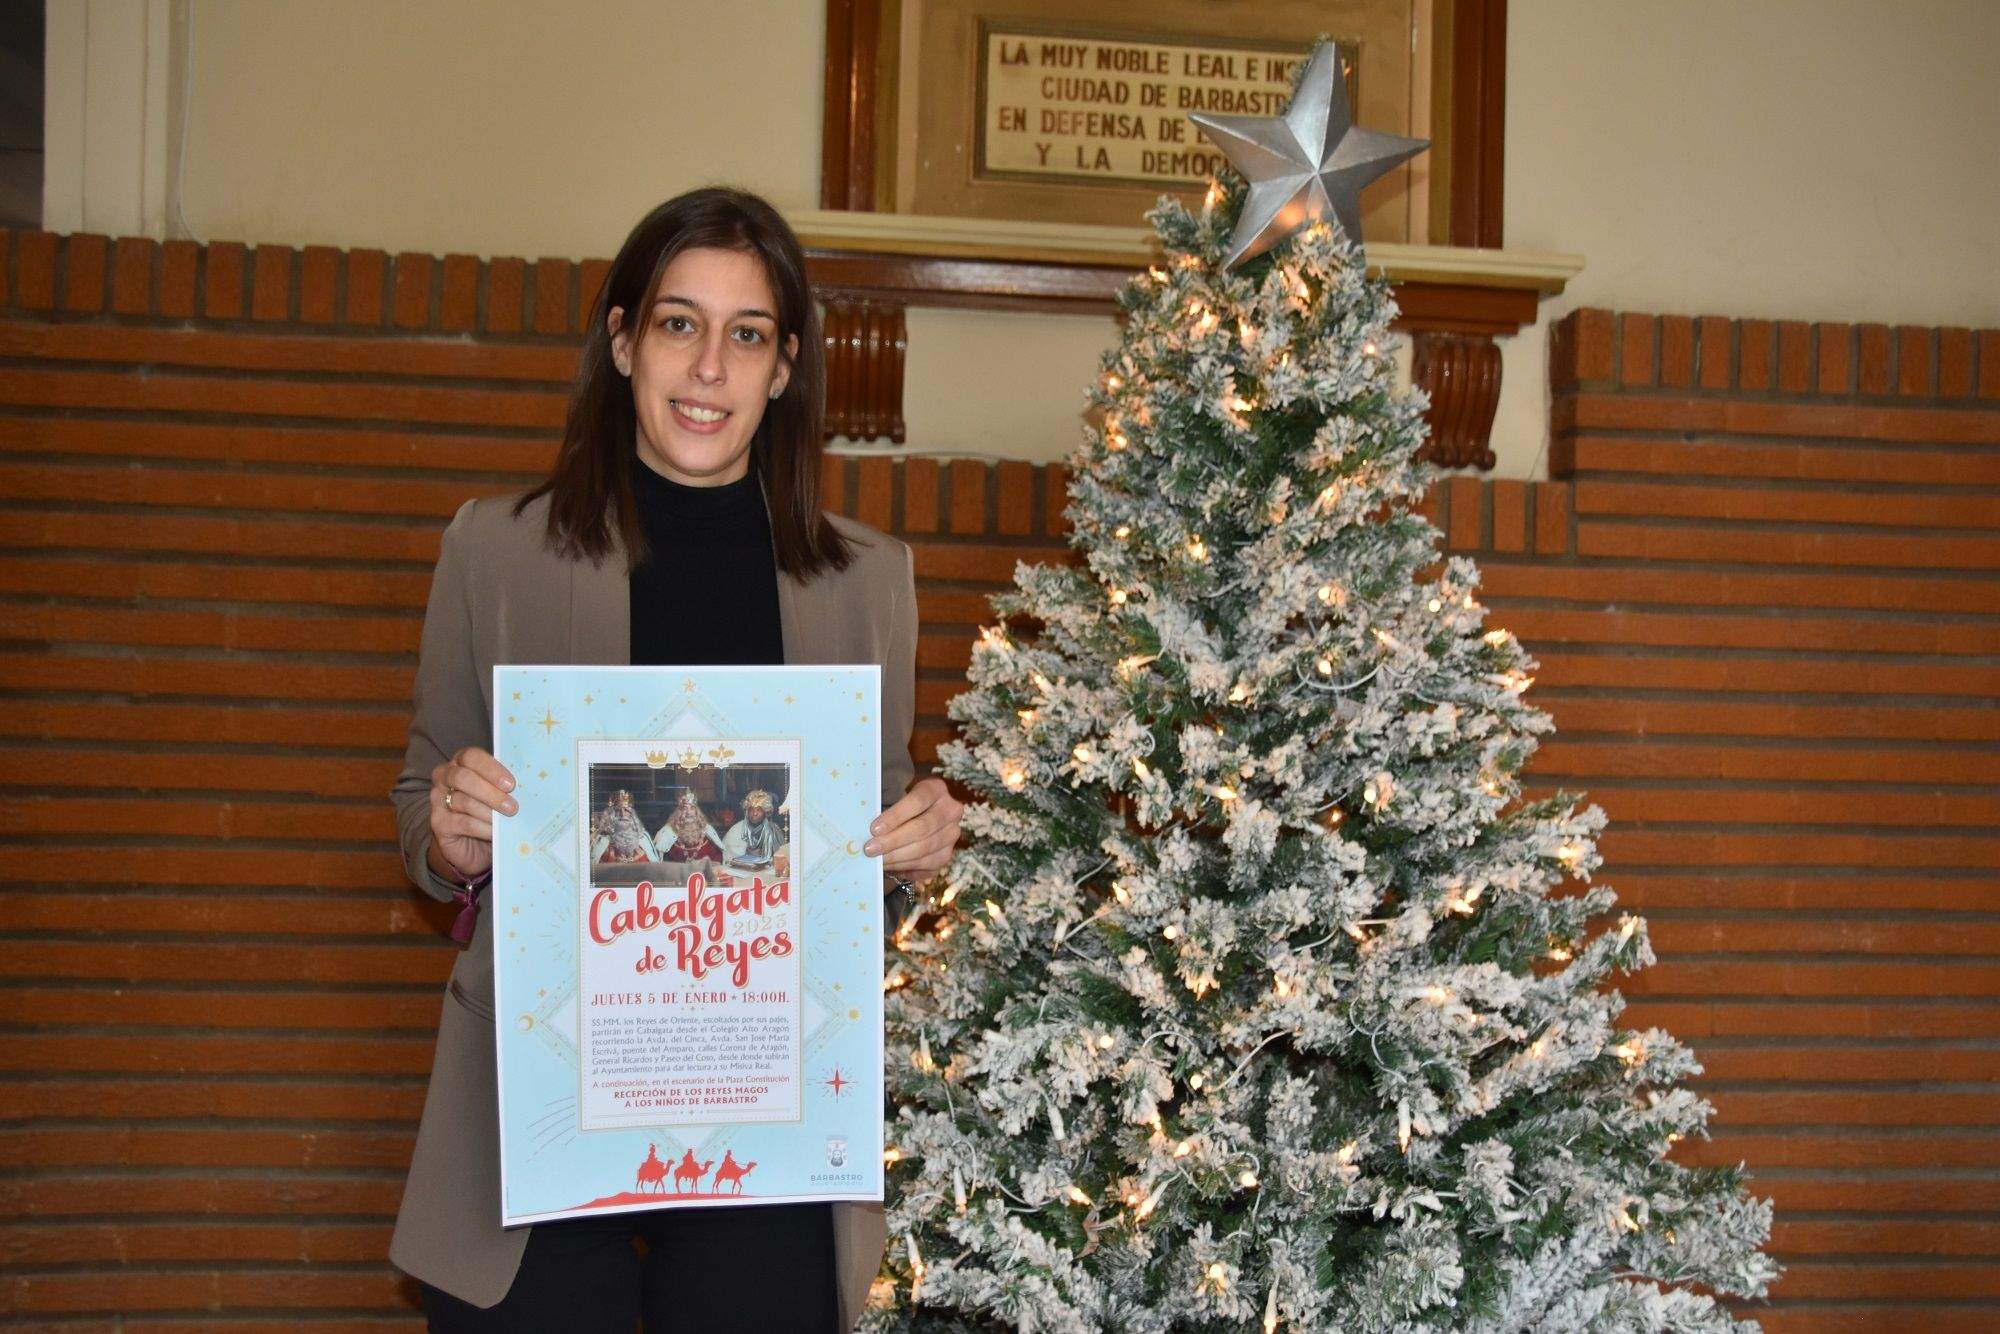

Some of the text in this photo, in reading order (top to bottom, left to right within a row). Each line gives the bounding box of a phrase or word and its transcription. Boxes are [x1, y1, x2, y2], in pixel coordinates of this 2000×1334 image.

[1000, 41, 1029, 67] LA
[1040, 45, 1088, 69] MUY
[1097, 48, 1170, 76] NOBLE
[1183, 53, 1238, 79] LEAL
[1246, 58, 1259, 81] E
[1041, 77, 1130, 105] CIUDAD
[1140, 81, 1168, 108] DE
[998, 106, 1027, 132] EN
[1041, 110, 1147, 142] DEFENSA
[1158, 117, 1185, 144] DE
[1034, 143, 1052, 167] Y
[1076, 145, 1112, 172] LA
[588, 872, 791, 945] Cabalgata
[635, 924, 794, 989] de Reyes
[591, 992, 642, 1007] JUEVES
[648, 992, 656, 1004] 5
[662, 992, 679, 1004] DE
[685, 991, 727, 1004] ENERO
[624, 1017, 635, 1025] los
[637, 1017, 657, 1026] Reyes
[670, 1016, 700, 1025] Oriente,
[703, 1016, 740, 1024] escoltados
[742, 1017, 754, 1025] por
[769, 1016, 789, 1025] pajes,
[592, 1028, 621, 1037] partirán
[637, 1026, 673, 1036] Cabalgata
[676, 1026, 698, 1034] desde
[700, 1025, 707, 1033] el
[710, 1025, 739, 1034] Colegio
[762, 1024, 790, 1034] Aragón
[592, 1037, 635, 1046] recorriendo
[646, 1036, 668, 1044] Avda.
[671, 1035, 682, 1043] del
[685, 1034, 708, 1044] Cinca,
[735, 1034, 748, 1042] San
[750, 1033, 766, 1043] José
[768, 1033, 790, 1041] María
[622, 1047, 648, 1055] puente
[663, 1045, 696, 1054] Amparo,
[698, 1044, 717, 1052] calles
[719, 1043, 747, 1052] Corona
[748, 1043, 758, 1051] de
[760, 1043, 790, 1053] Aragón,
[592, 1057, 620, 1066] General
[622, 1055, 653, 1064] Ricardos
[661, 1054, 681, 1063] Paseo
[682, 1054, 693, 1062] del
[695, 1053, 716, 1063] Coso,
[719, 1053, 738, 1061] desde
[740, 1052, 763, 1061] donde
[764, 1052, 790, 1061] subirán
[592, 1067, 599, 1075] al
[601, 1066, 653, 1076] Ayuntamiento
[654, 1065, 671, 1074] para
[672, 1064, 685, 1072] dar
[687, 1063, 712, 1072] lectura
[730, 1062, 753, 1070] Misiva
[755, 1061, 772, 1070] Real.
[592, 1081, 599, 1089] A
[601, 1079, 650, 1089] continuación,
[663, 1078, 670, 1086] el
[671, 1077, 705, 1086] escenario
[706, 1076, 716, 1084] de
[717, 1076, 724, 1084] la
[726, 1075, 744, 1084] Plaza
[745, 1074, 790, 1084] Constitución
[614, 1086, 769, 1099] RECEPCIÓN DE LOS REYES MAGOS
[624, 1100, 632, 1108] A
[635, 1099, 652, 1108] LOS
[688, 1097, 700, 1105] DE
[703, 1096, 758, 1105] BARBASTRO
[810, 1174, 864, 1182] BARBASTRO
